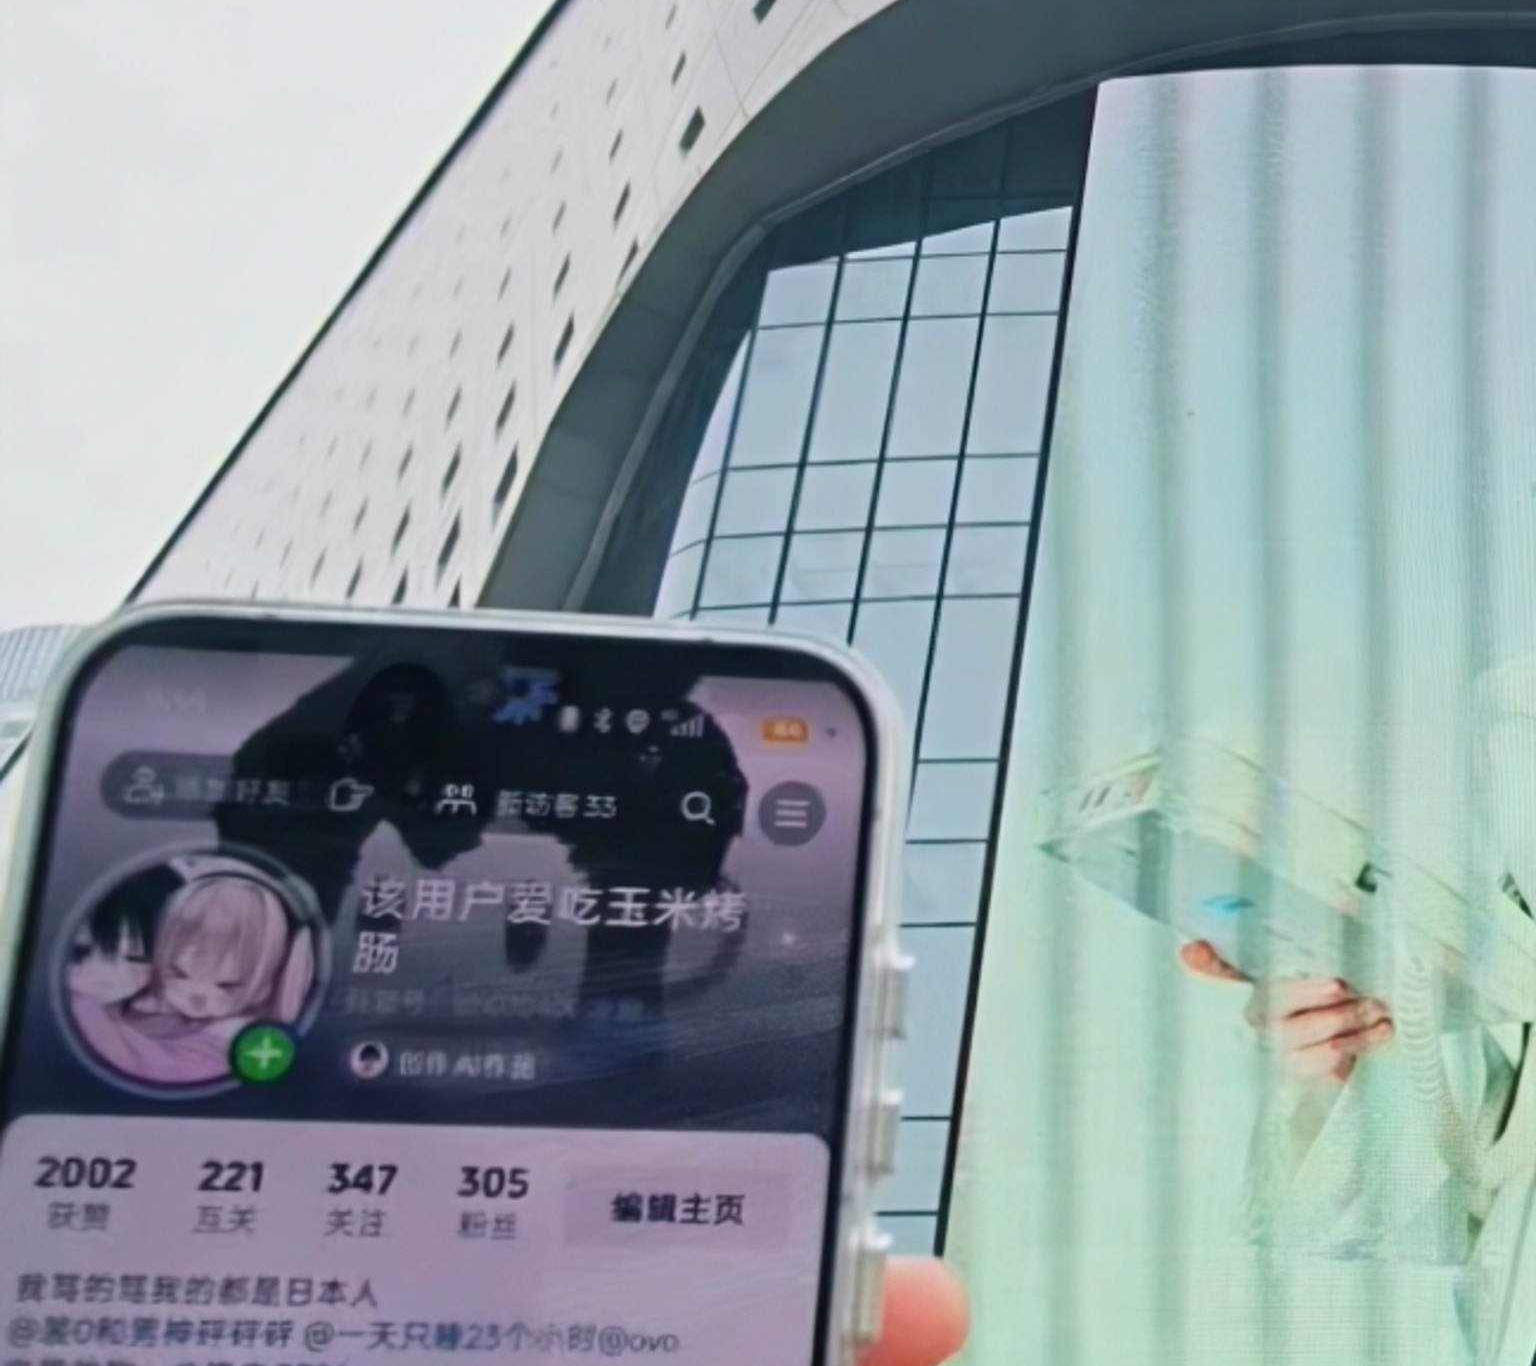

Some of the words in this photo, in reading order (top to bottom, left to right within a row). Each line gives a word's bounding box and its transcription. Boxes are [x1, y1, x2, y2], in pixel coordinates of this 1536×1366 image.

[361, 878, 747, 932] 该用户爱吃玉米烤
[353, 931, 398, 974] 肠
[34, 1157, 137, 1189] 2002
[196, 1161, 264, 1192] 221
[327, 1163, 398, 1195] 347
[456, 1166, 530, 1199] 305
[193, 1205, 257, 1234] 互关
[324, 1208, 388, 1237] 关注
[458, 1210, 518, 1239] 粉丝
[610, 1192, 746, 1227] 编辑主页
